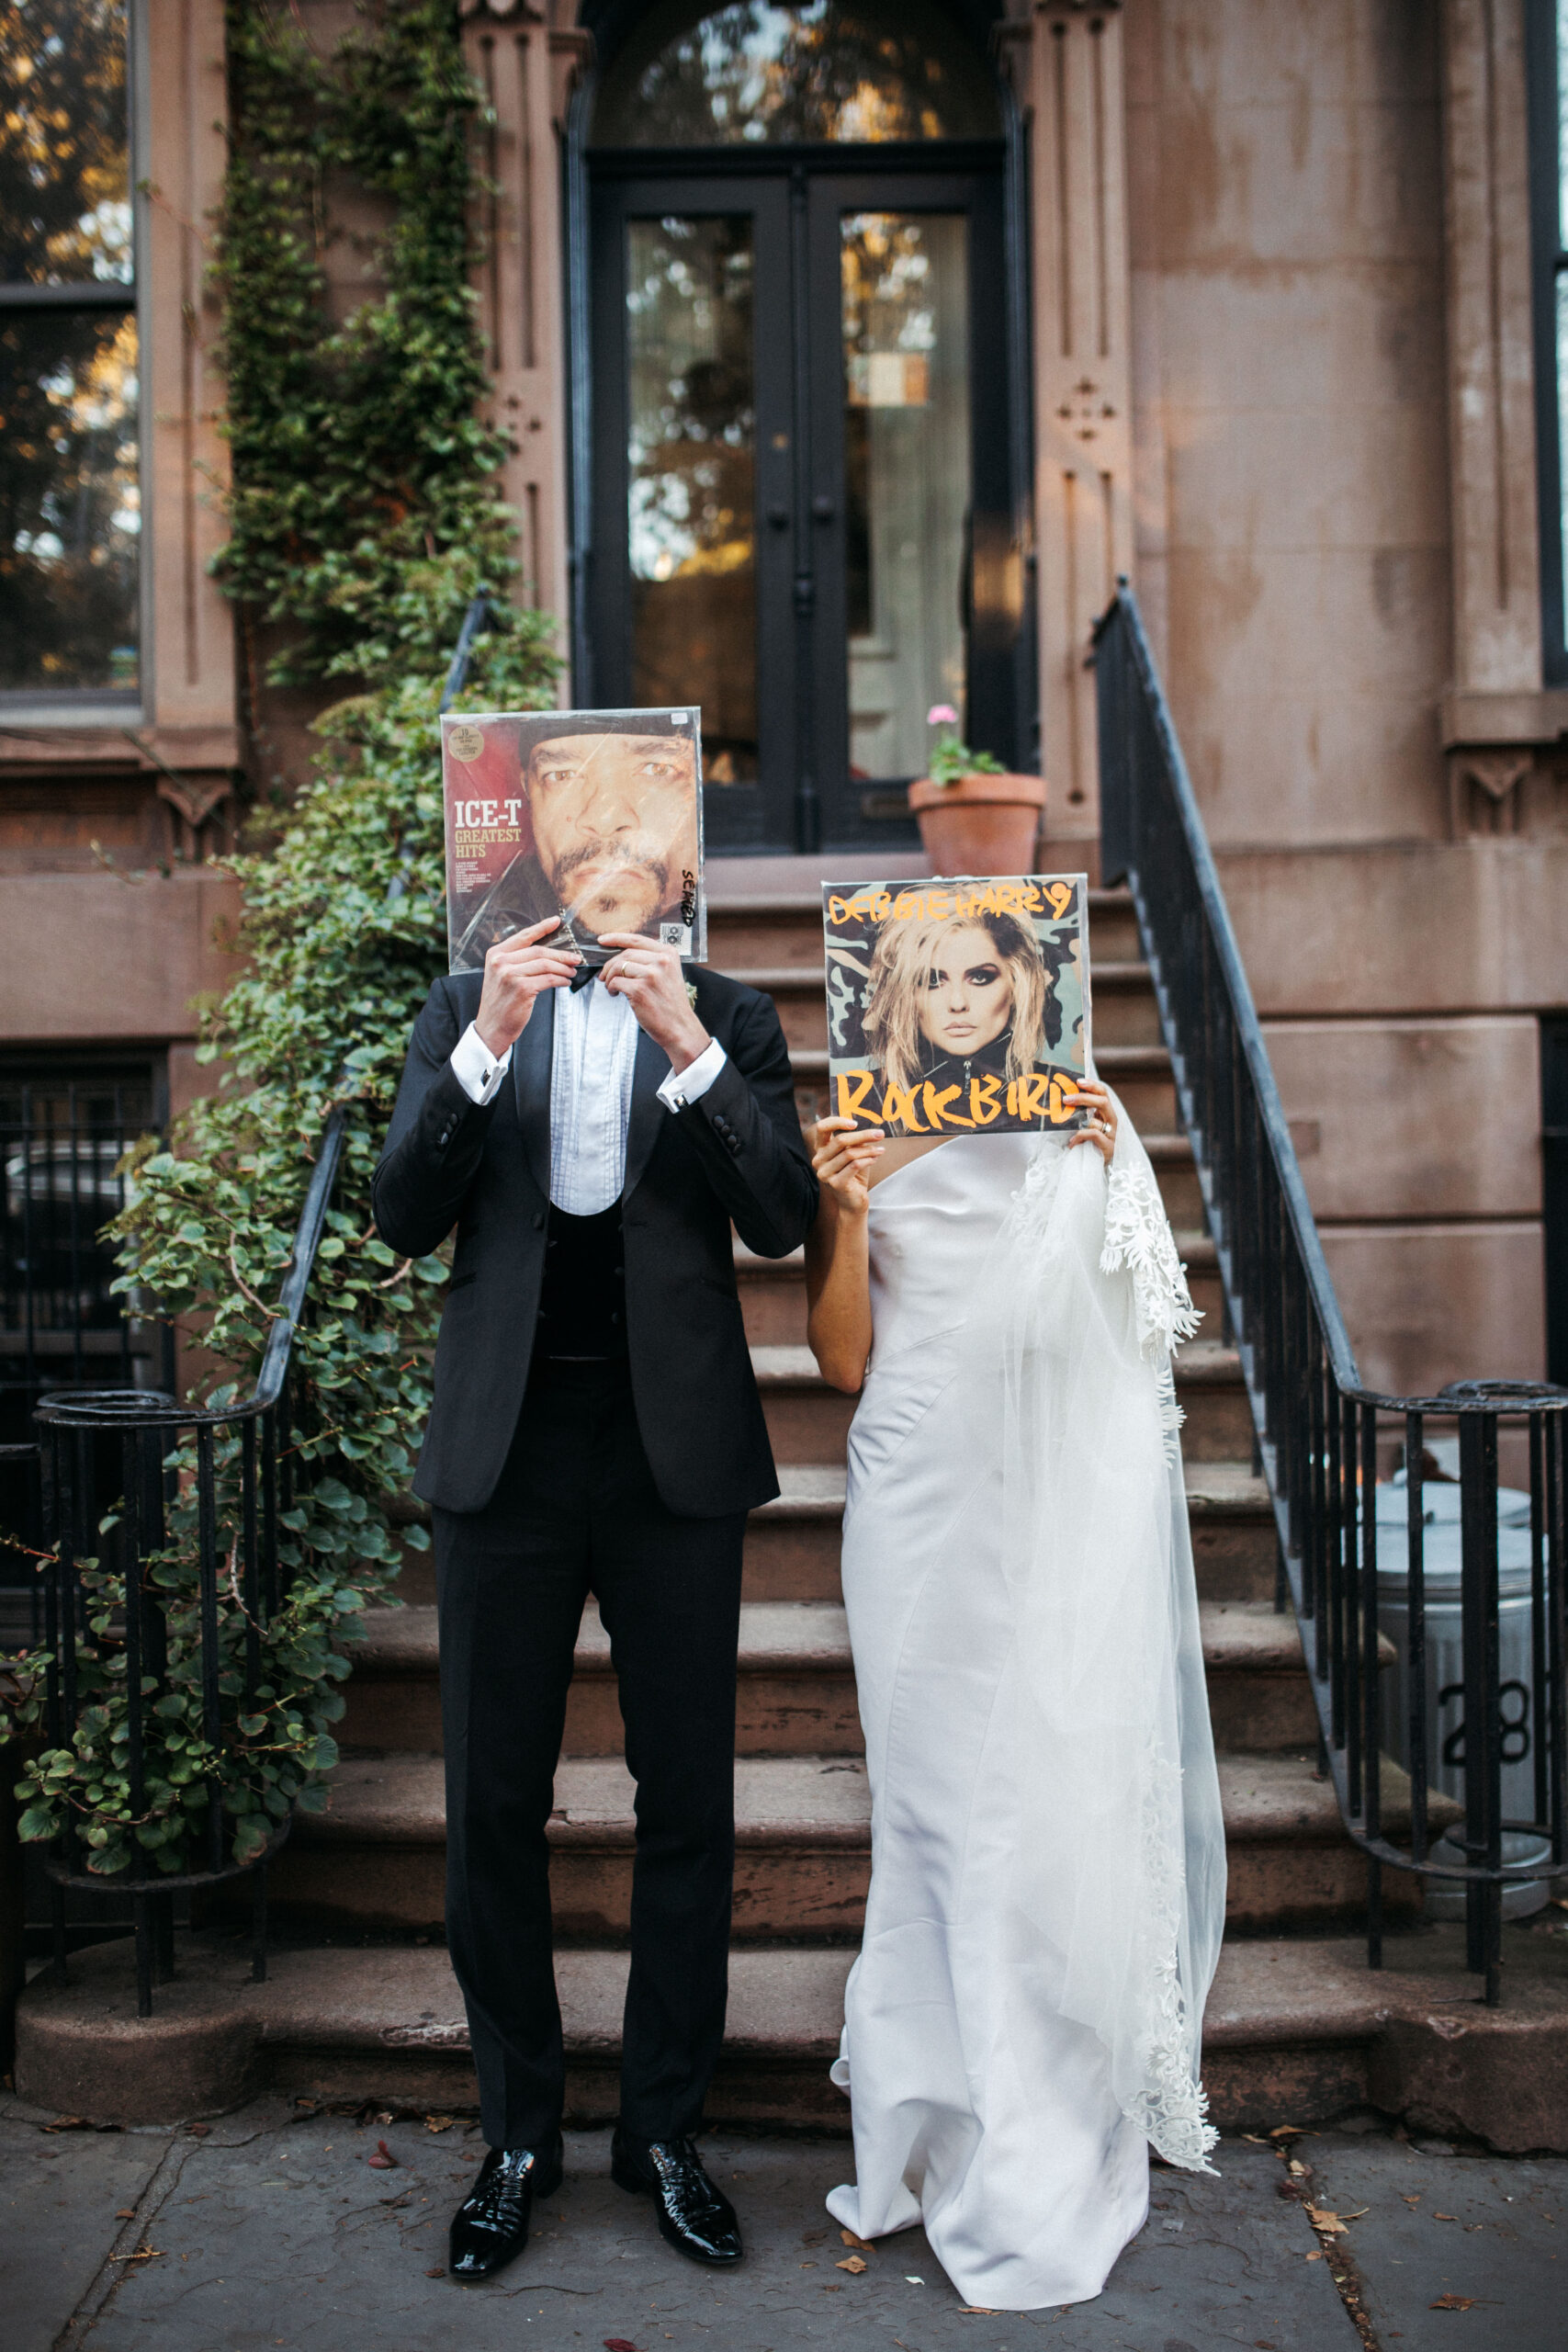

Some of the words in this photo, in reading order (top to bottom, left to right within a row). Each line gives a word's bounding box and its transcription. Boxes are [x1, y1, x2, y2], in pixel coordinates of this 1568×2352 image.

[454, 799, 522, 828] ICE-T
[455, 828, 522, 844] GREATEST
[455, 843, 487, 858] HITS
[829, 891, 949, 925] DEBBIE
[955, 884, 1073, 921] HARRY
